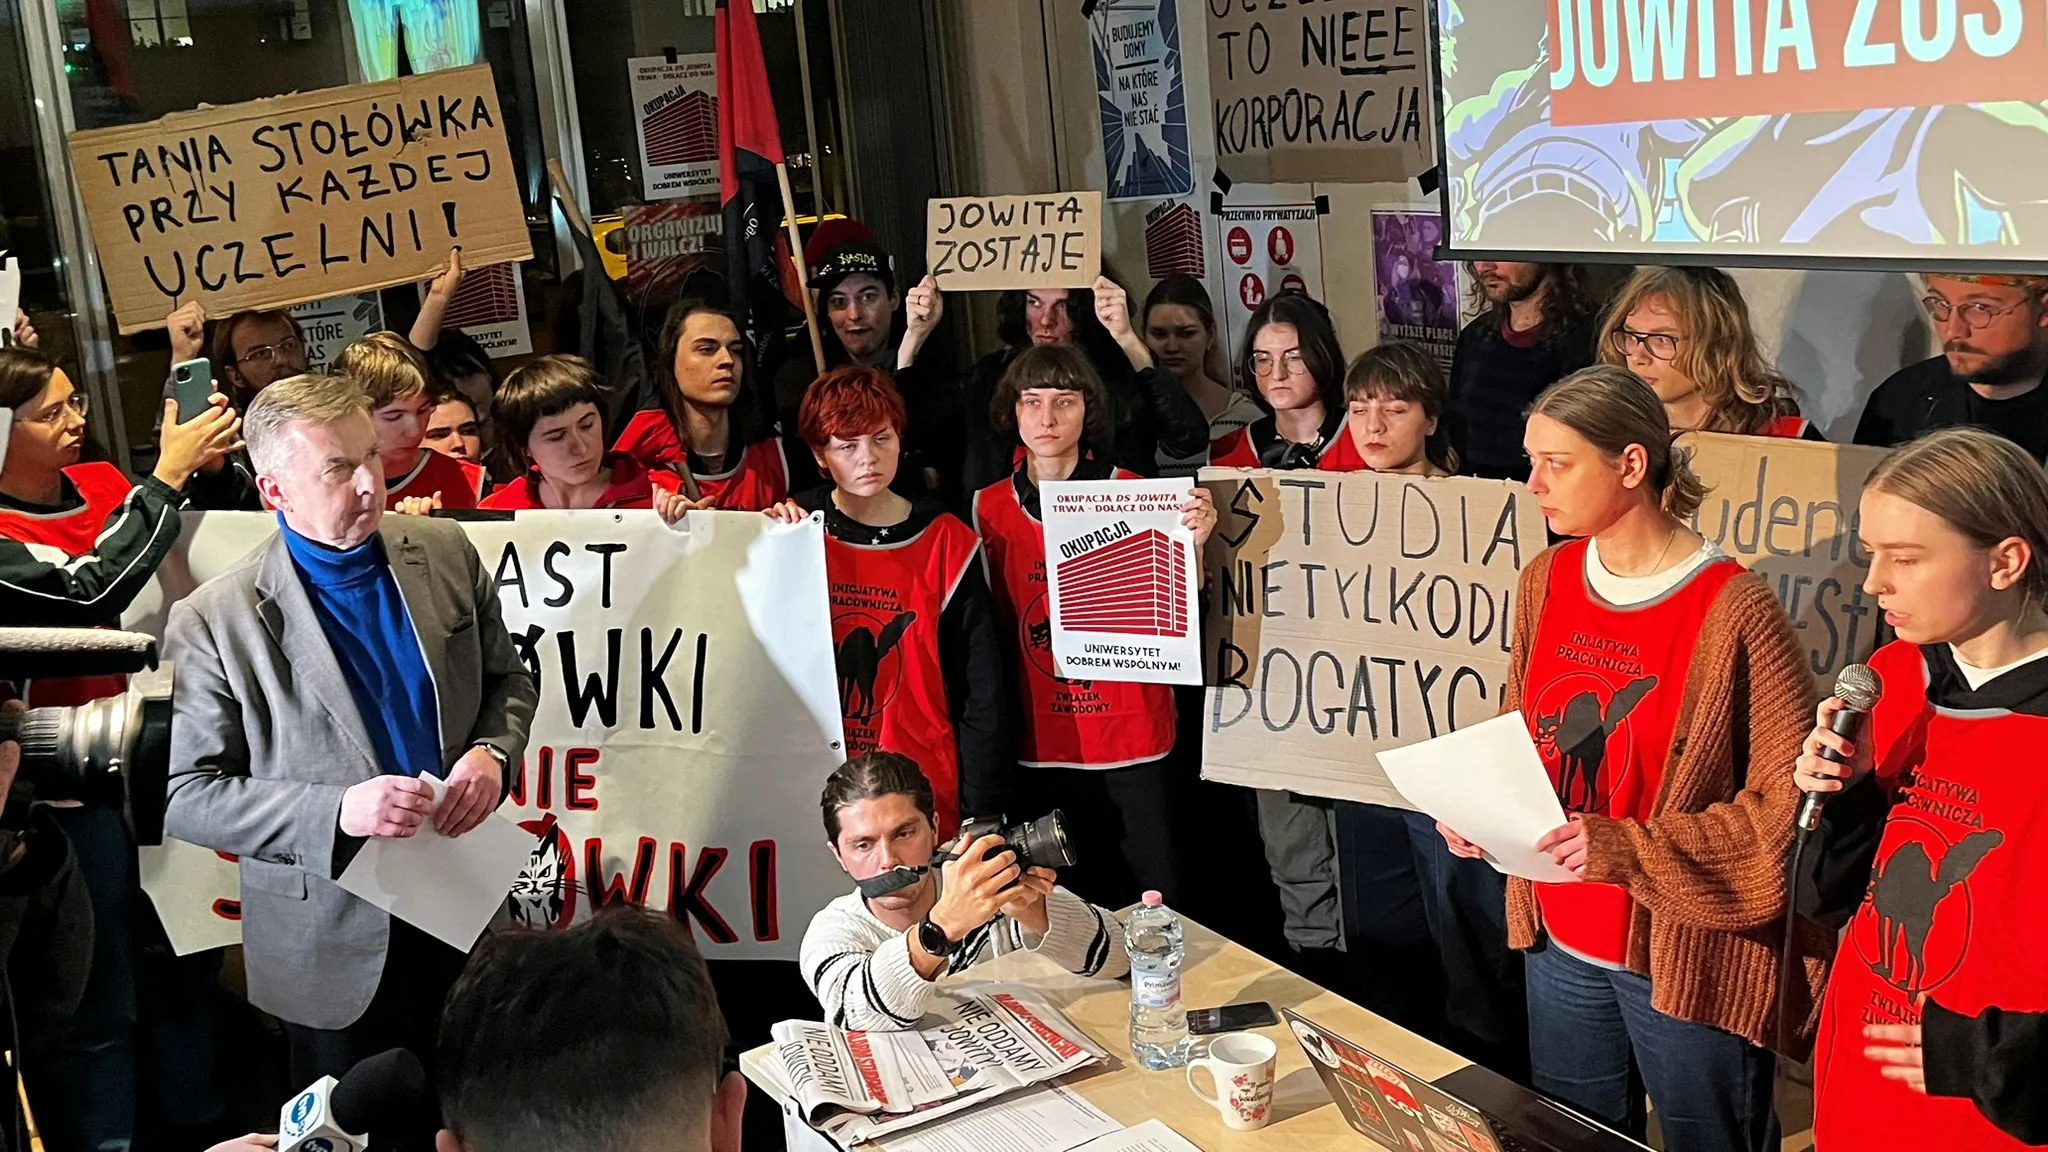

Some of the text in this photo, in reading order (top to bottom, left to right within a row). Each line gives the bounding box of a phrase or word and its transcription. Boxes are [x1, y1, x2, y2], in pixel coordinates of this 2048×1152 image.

[1112, 20, 1155, 42] BUDUJEMY
[1217, 7, 1416, 80] TO NIEEE
[1123, 41, 1146, 59] DOMY
[1119, 68, 1159, 91] NA KTÓRE
[643, 84, 686, 115] OKUPACJA
[1131, 91, 1148, 108] NAS
[1124, 104, 1160, 127] NIE STAĆ
[1217, 87, 1420, 156] KORPORACJA
[98, 96, 493, 187] TANIA STOŁÓWKA
[653, 181, 681, 190] DOBREM
[664, 169, 711, 180] UNIWERSYTET
[122, 181, 237, 243] PRZY
[938, 197, 1083, 234] JOWITA
[1221, 209, 1315, 220] PRZECIWKO PRYWATYZACJI
[628, 214, 724, 242] ORGANIZUJ
[630, 235, 705, 261] I WALCZ!
[933, 232, 1084, 276] ZOSTAJE
[1053, 505, 1085, 513] TRWA
[1095, 505, 1136, 514] DOŁĄCZ
[1139, 504, 1155, 512] DO
[1057, 495, 1112, 503] OKUPACJA
[1134, 493, 1177, 502] JOWITA
[1218, 477, 1520, 571] STUDIA
[1060, 520, 1132, 559] OKUPACJA
[495, 541, 627, 608] AST
[832, 582, 898, 599] INICJATYWA
[1066, 656, 1181, 671] DOBREM WSPÓLNYM!
[1085, 643, 1160, 657] UNIWERSYTET
[1212, 637, 1507, 740] BOGATYC
[1051, 703, 1110, 714] ZAWODOWY
[940, 1026, 1004, 1070] JOWITY!
[954, 1000, 991, 1025] NIE
[977, 1022, 1047, 1072] ODDAMY
[802, 1027, 849, 1099] NIE ODDAMY
